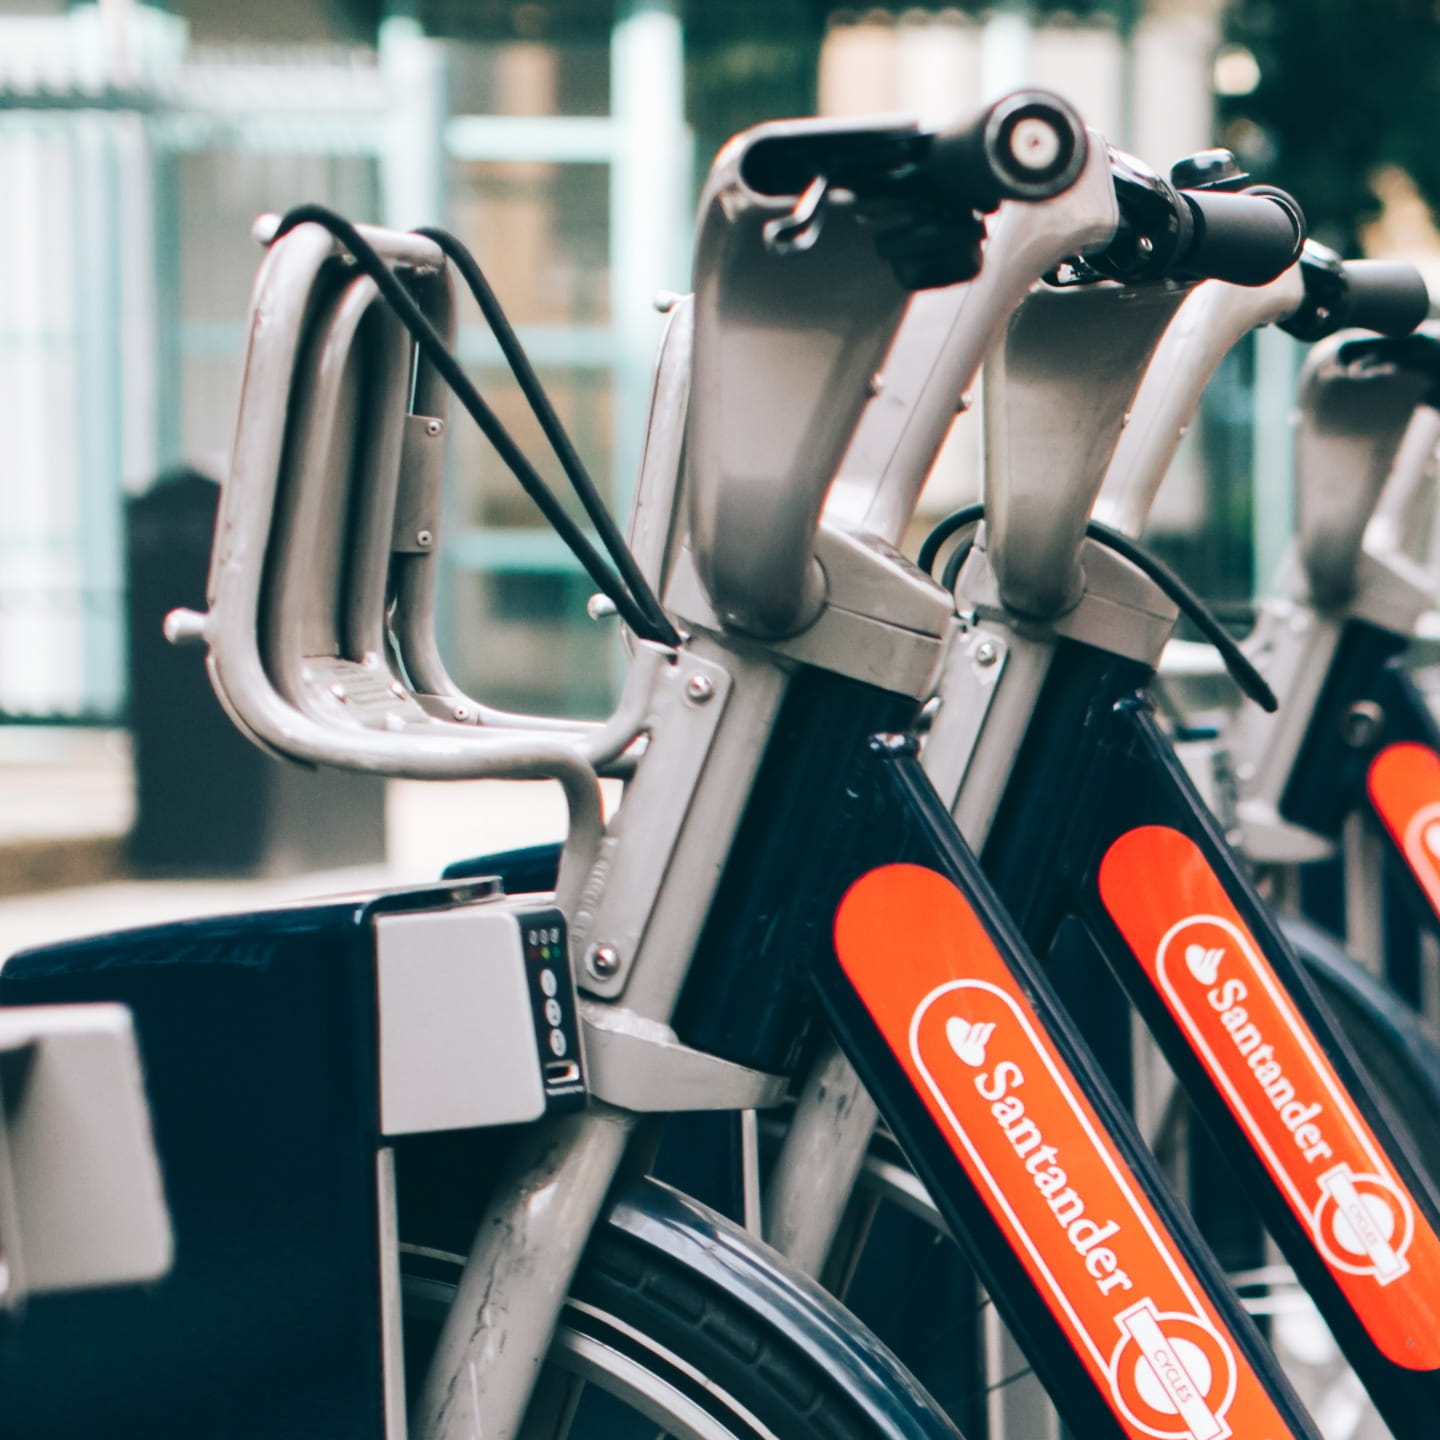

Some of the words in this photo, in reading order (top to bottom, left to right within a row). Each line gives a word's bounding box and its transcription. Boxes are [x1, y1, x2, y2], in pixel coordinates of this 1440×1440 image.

[1207, 979, 1334, 1164] Santander
[974, 1060, 1134, 1297] Santander
[1153, 1348, 1193, 1404] CYCLES
